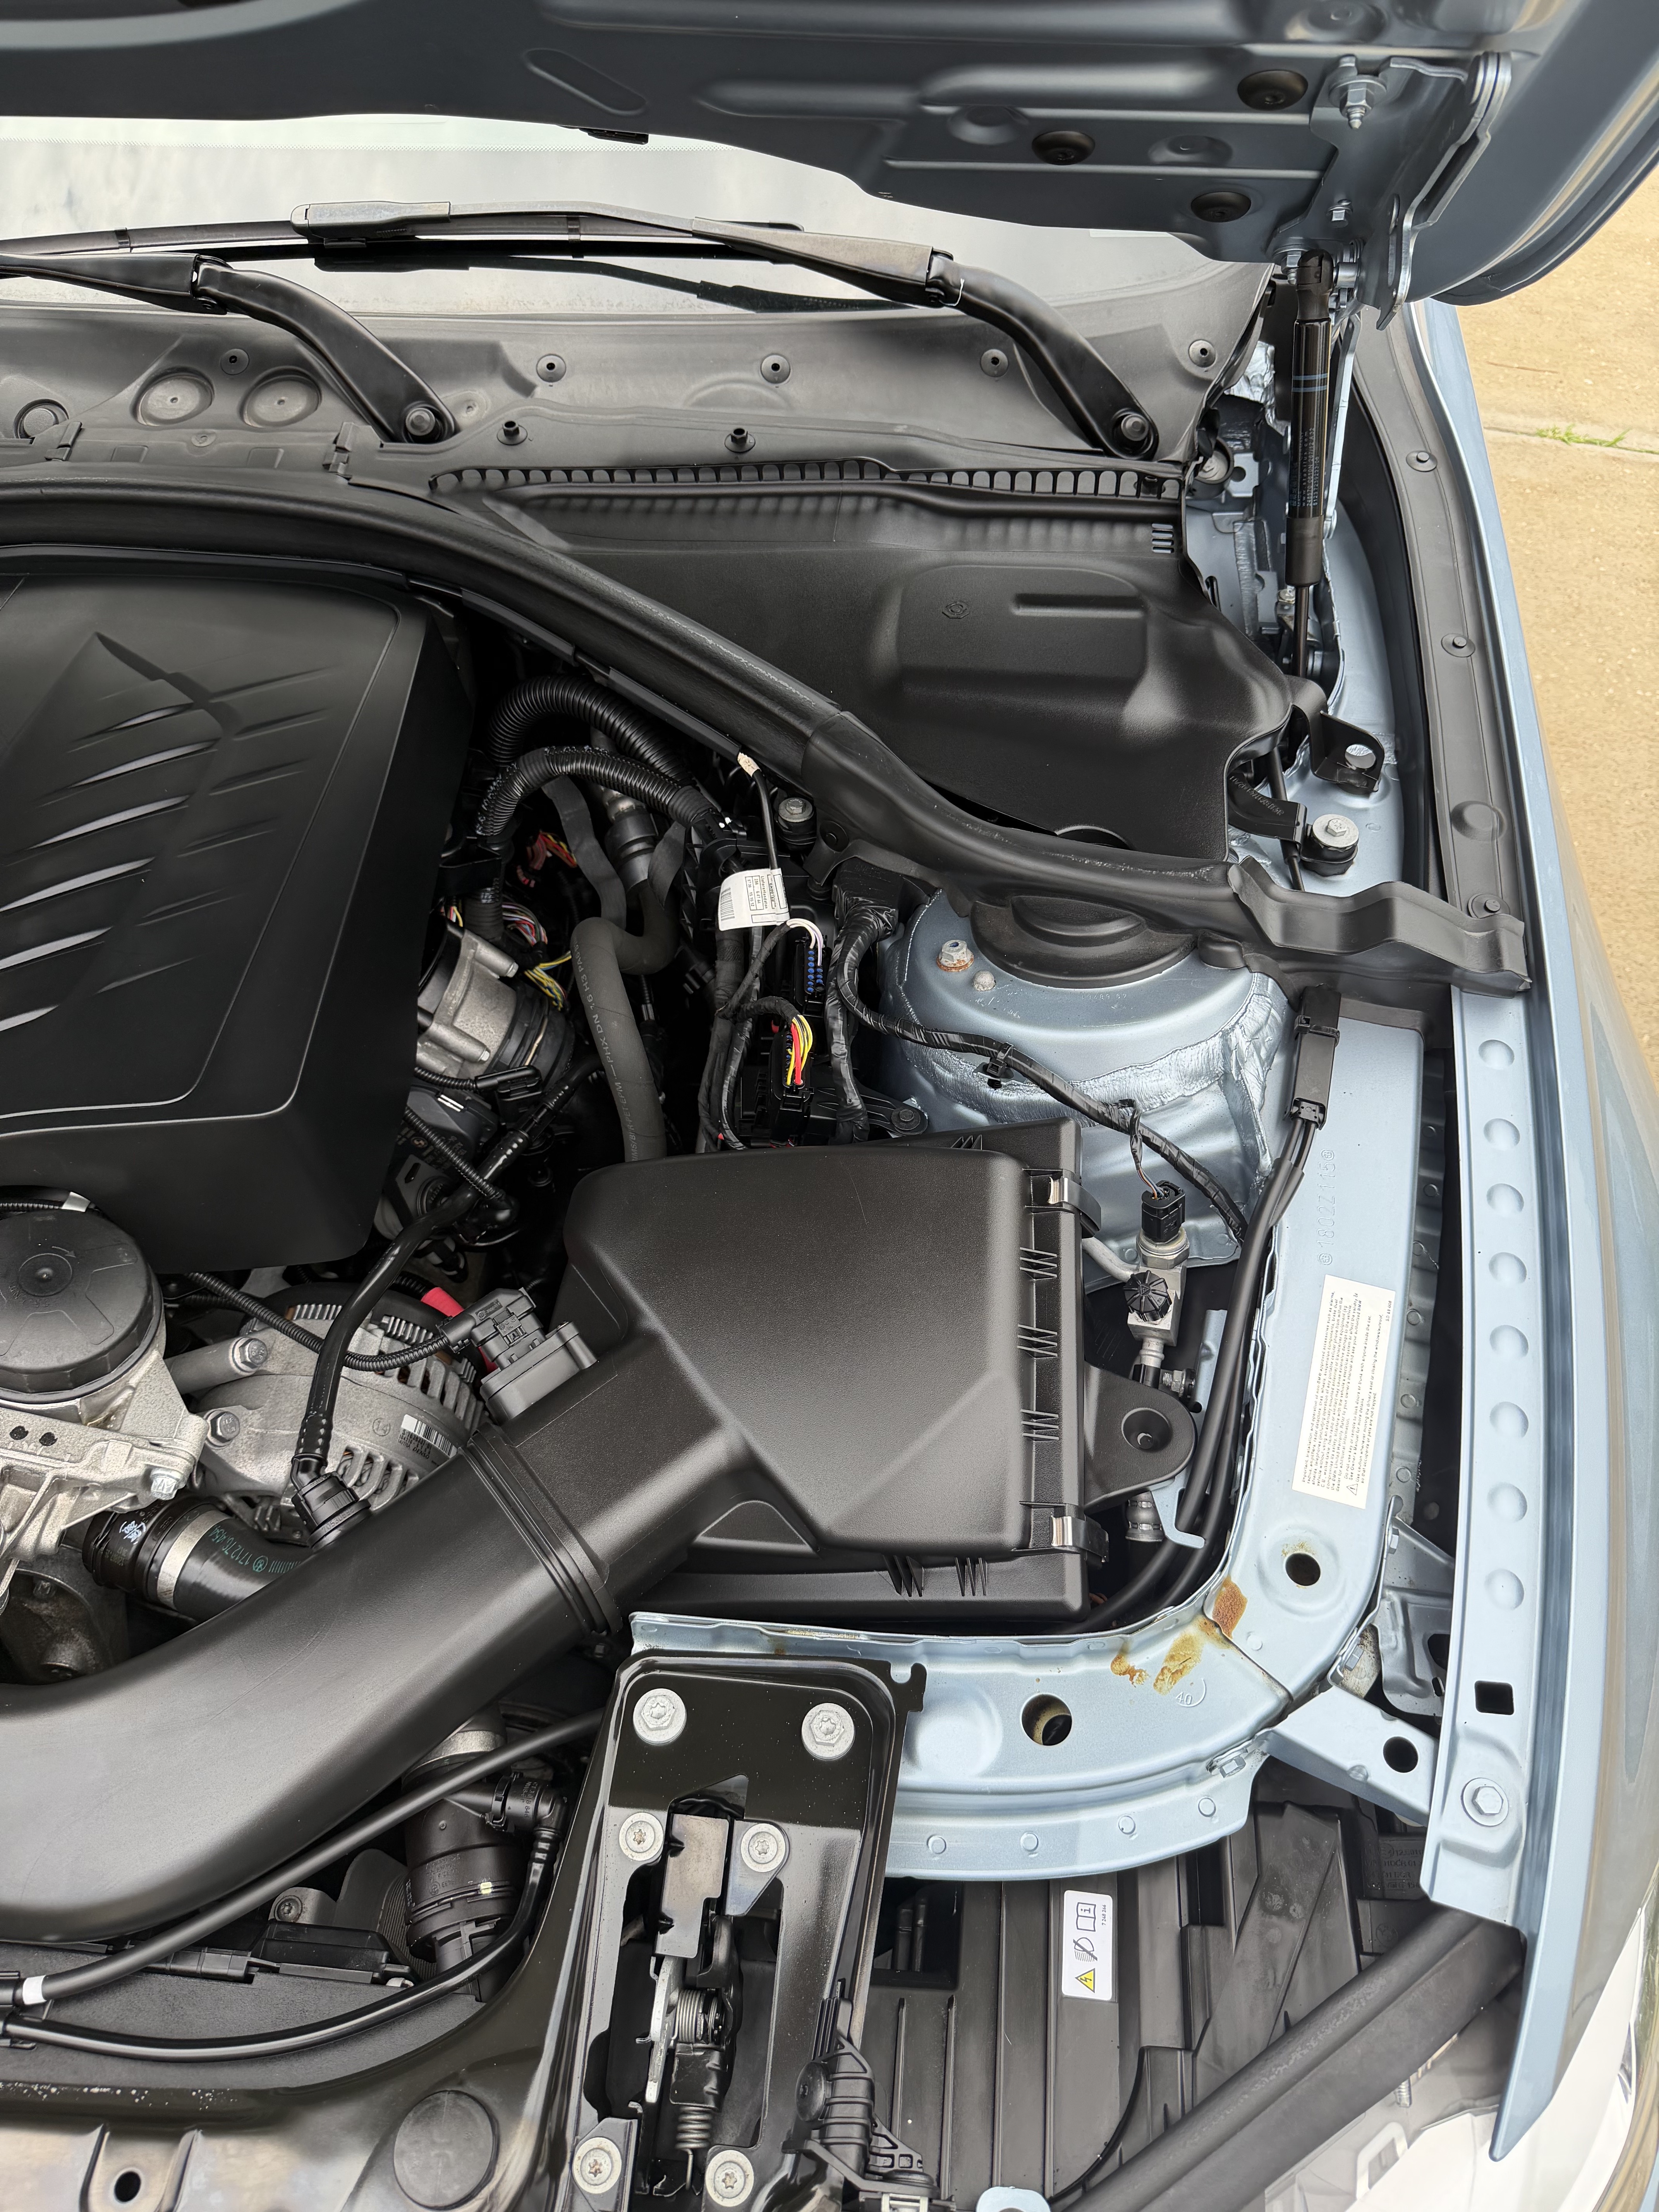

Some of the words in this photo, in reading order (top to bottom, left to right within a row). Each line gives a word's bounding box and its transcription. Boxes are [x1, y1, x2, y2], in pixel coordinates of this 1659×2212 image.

[592, 1013, 605, 1034] DN
[600, 1036, 613, 1063] PHX
[412, 1447, 430, 1460] DENSO
[231, 1545, 253, 1566] 1712
